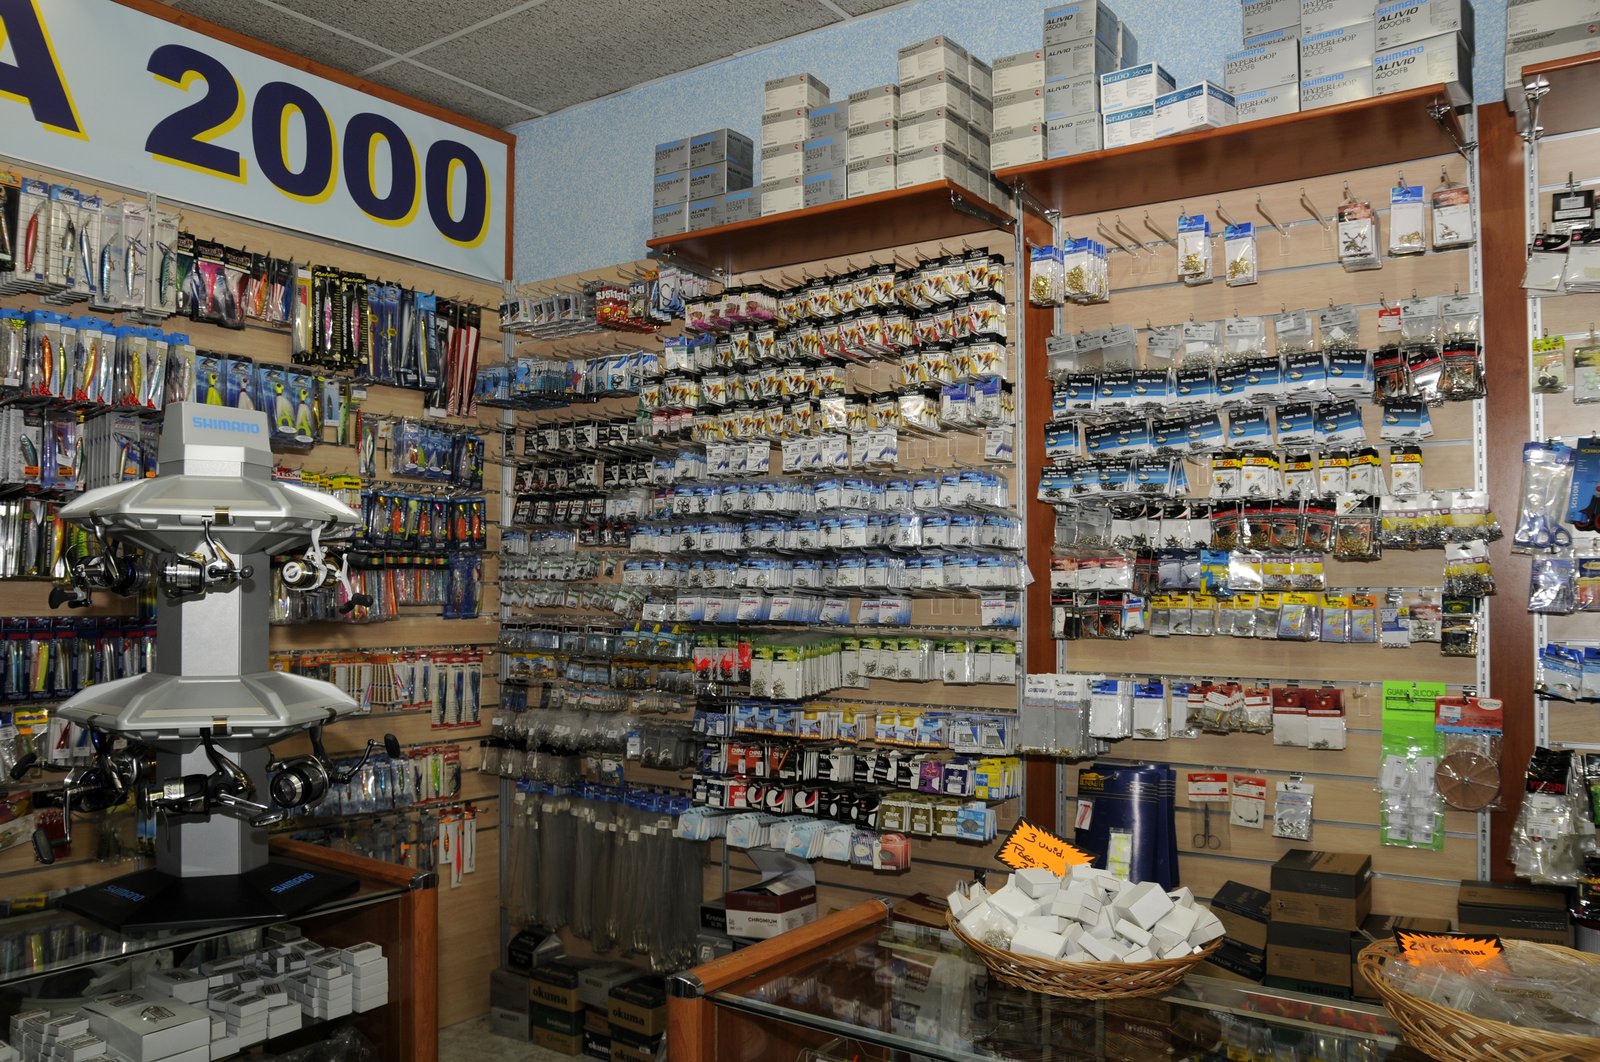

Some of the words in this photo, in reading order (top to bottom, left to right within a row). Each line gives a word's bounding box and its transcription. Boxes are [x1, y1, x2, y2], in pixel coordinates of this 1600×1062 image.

[1046, 15, 1073, 24] ALIVIO
[1378, 7, 1419, 23] ALIVIO
[1378, 16, 1411, 31] 4000FB
[1302, 28, 1344, 44] SHIMANO
[1302, 34, 1356, 52] HYPERLOOP
[1048, 48, 1071, 56] ALIVIO
[1375, 46, 1424, 65] SHIMANO
[1227, 52, 1277, 69] HYPERLOOP
[1376, 57, 1416, 73] ALIVIO
[1302, 72, 1344, 88] SHIMANO
[1375, 66, 1409, 81] 4000FB
[1046, 84, 1070, 93] ALIVIO
[1302, 79, 1356, 97] HYPERLOOP
[1236, 95, 1278, 110] YPERLOOP
[1106, 113, 1133, 122] SEIDO
[1049, 123, 1073, 131] ALIVIO
[145, 44, 491, 248] 2000
[192, 416, 260, 434] SHIMANO
[1571, 480, 1579, 509] SCISSORS
[1024, 833, 1037, 843] 3
[270, 872, 313, 894] SHIMANO
[533, 986, 568, 1005] okuma
[613, 1007, 645, 1026] okuma
[588, 1041, 611, 1054] okum
